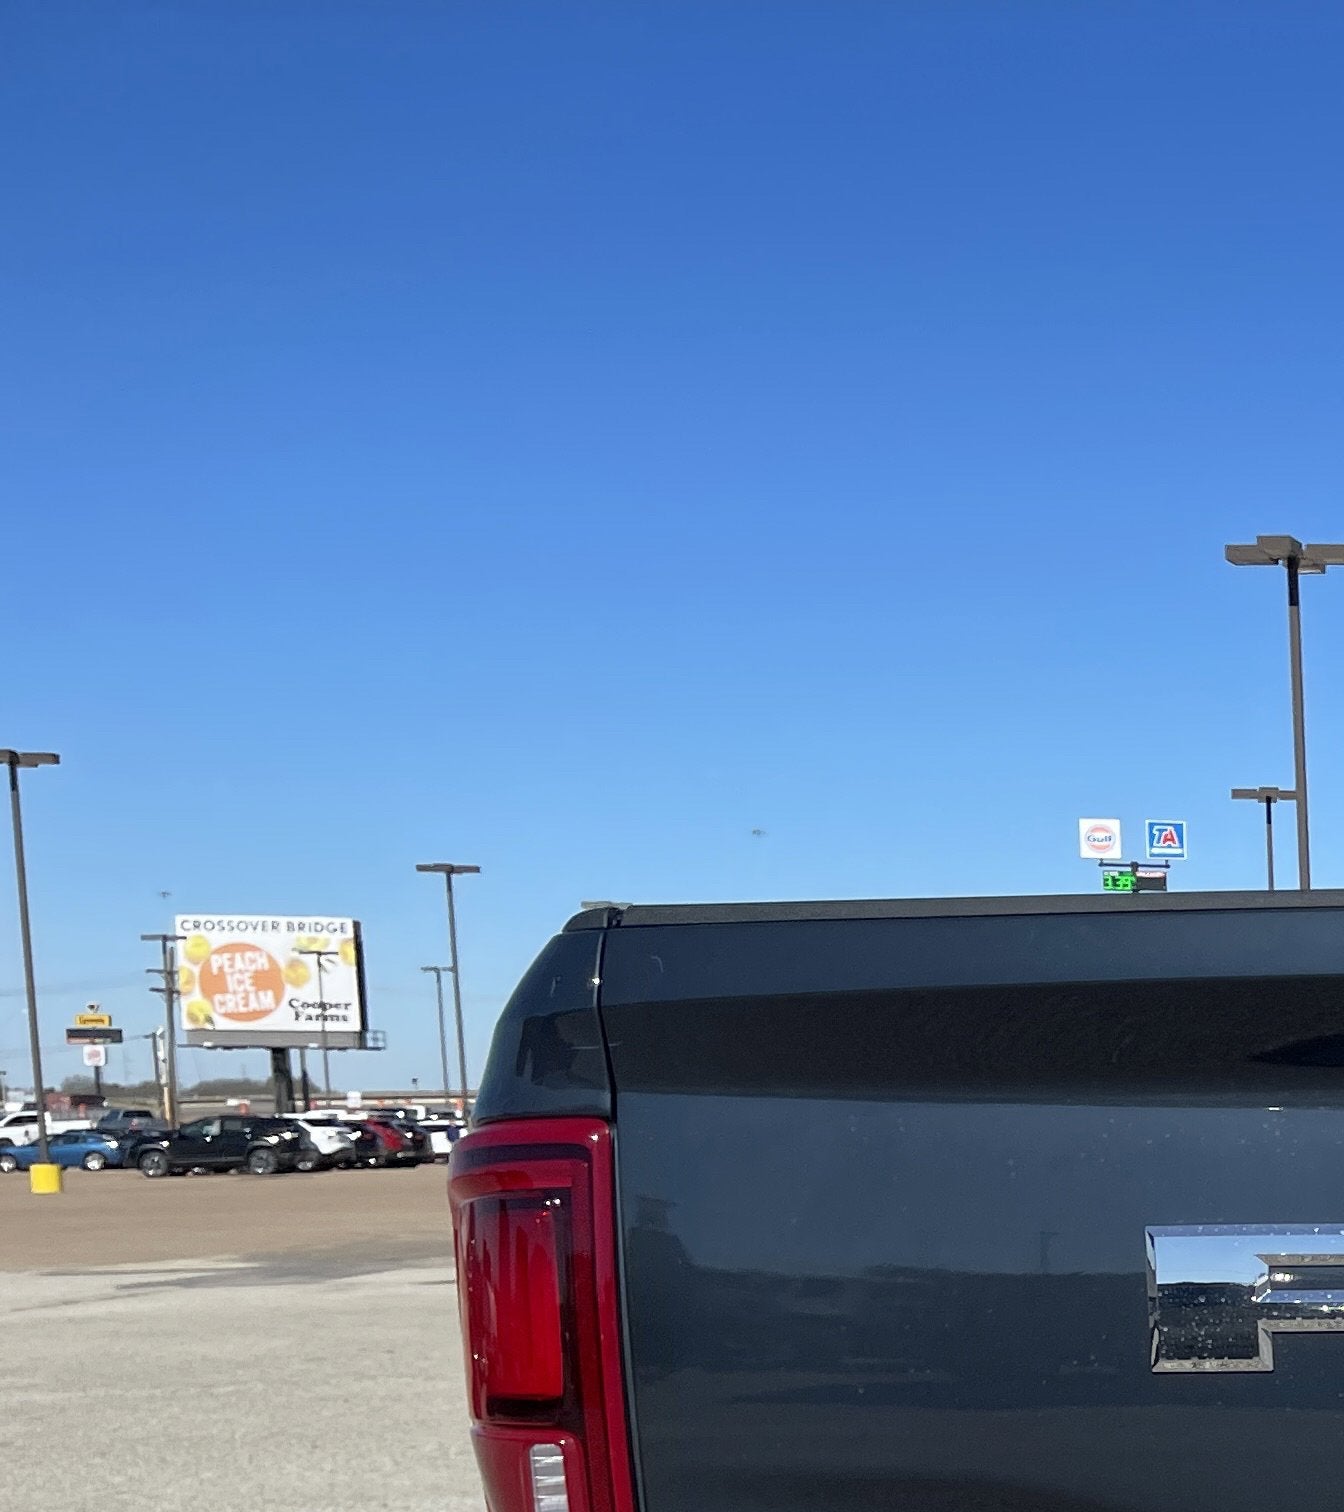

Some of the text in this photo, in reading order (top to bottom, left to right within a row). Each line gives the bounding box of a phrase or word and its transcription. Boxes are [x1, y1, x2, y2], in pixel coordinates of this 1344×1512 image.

[1087, 833, 1112, 843] Gulf
[1153, 825, 1180, 848] TA
[180, 919, 348, 934] CROSSOVER BRIDGE
[210, 951, 270, 975] PEACH
[226, 972, 256, 992] ICE
[213, 989, 276, 1014] CREAM
[288, 998, 352, 1013] Cooper
[294, 1010, 349, 1022] Farms
